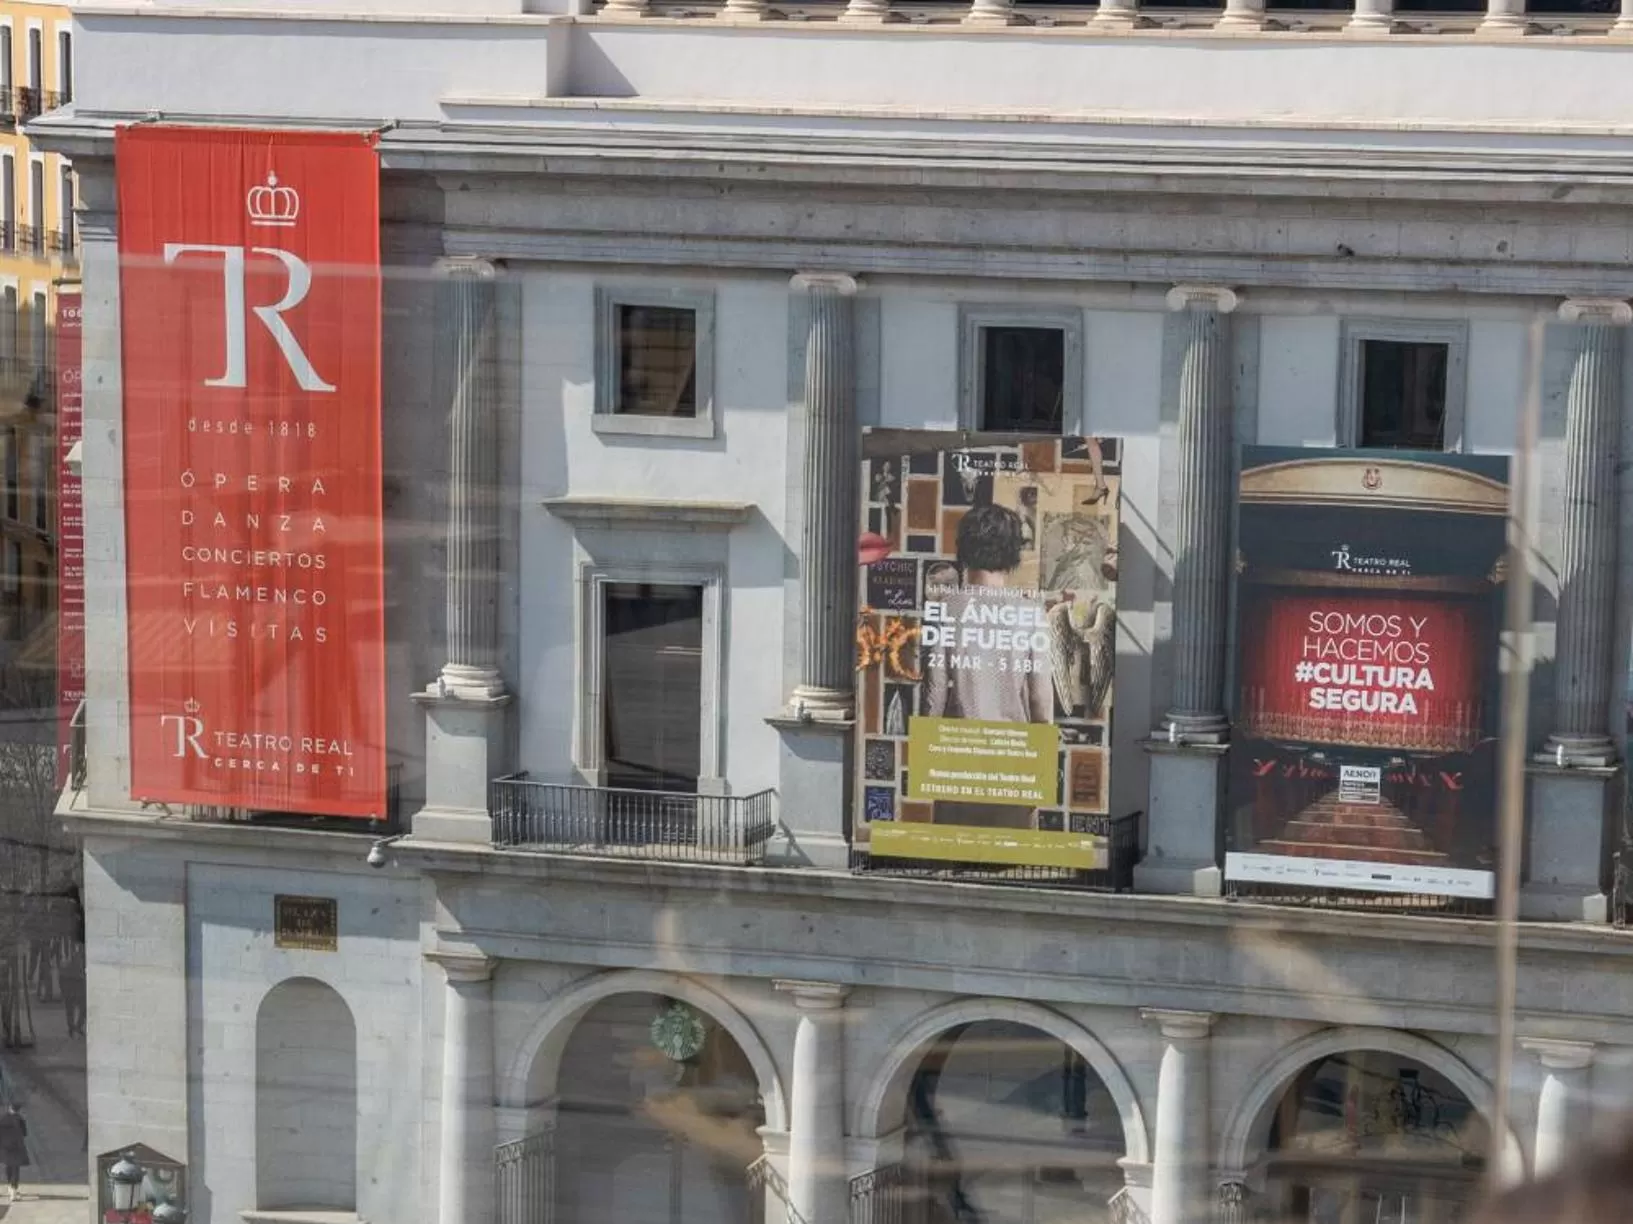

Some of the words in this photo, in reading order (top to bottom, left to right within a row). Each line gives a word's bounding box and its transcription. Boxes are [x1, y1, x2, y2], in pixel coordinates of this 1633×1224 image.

[188, 417, 253, 436] desde
[269, 421, 317, 440] 1818
[180, 467, 326, 496] ÓPERA
[181, 510, 327, 533] DANZA
[182, 546, 327, 570] CONCIERTOS
[183, 581, 328, 606] FLAMENCO
[923, 600, 956, 624] EL
[960, 598, 1050, 627] ÁNGEL
[1308, 611, 1402, 639] SOMOS
[1408, 616, 1428, 639] Y
[184, 619, 328, 643] VISITAS
[922, 626, 956, 648] DE
[961, 628, 1051, 652] FUEGO
[927, 653, 944, 669] 22
[949, 654, 981, 671] MAR
[1014, 658, 1043, 674] ABR
[1302, 637, 1430, 666] HACEMOS
[1294, 661, 1435, 690] #CULTURA
[1308, 687, 1419, 716] SEGURA
[214, 731, 292, 753] TEATRO
[301, 735, 354, 757] REAL
[213, 756, 281, 772] CERCA
[296, 762, 320, 775] DE
[335, 766, 355, 778] TI
